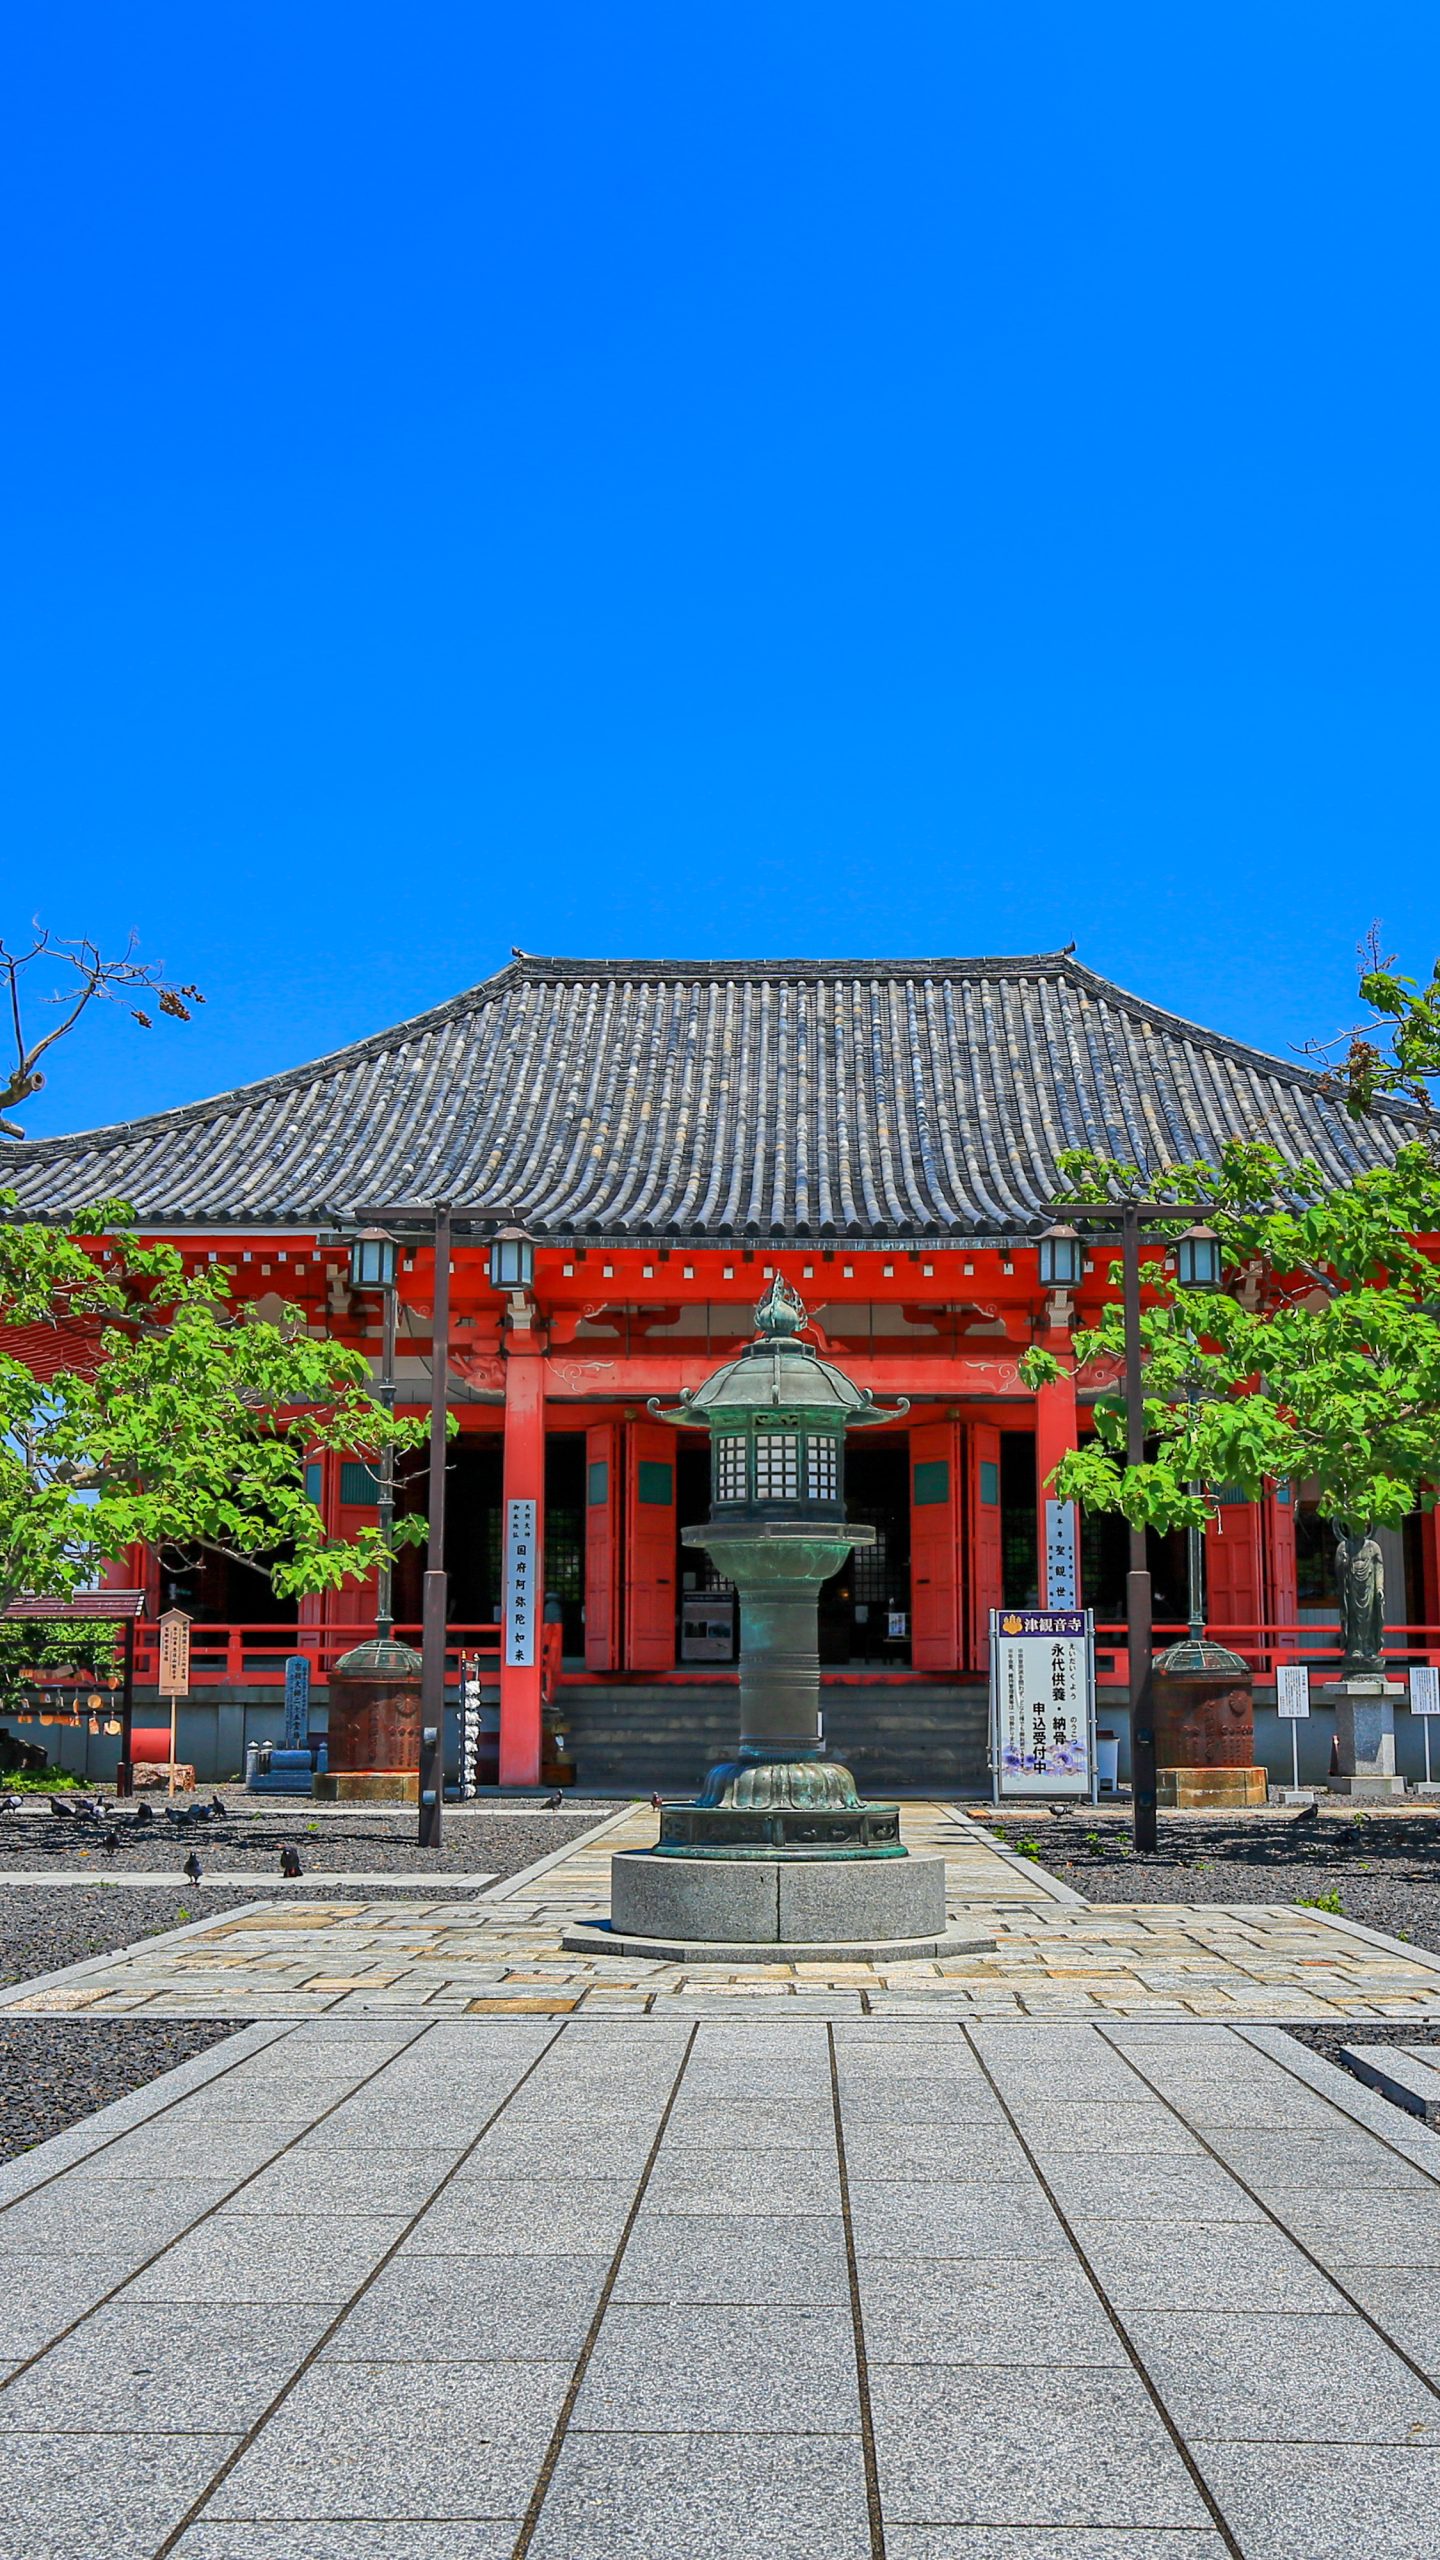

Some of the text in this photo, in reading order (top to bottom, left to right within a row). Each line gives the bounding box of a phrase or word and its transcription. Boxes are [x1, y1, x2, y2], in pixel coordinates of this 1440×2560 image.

[515, 1544, 527, 1662] 国府阿弥陀如来
[1024, 1617, 1082, 1632] 津観音寺
[1032, 1702, 1046, 1774] 申込受付中
[1051, 1643, 1067, 1745] 永代供養・納骨
[1068, 1643, 1078, 1745] えいだいくよう のうこつ
